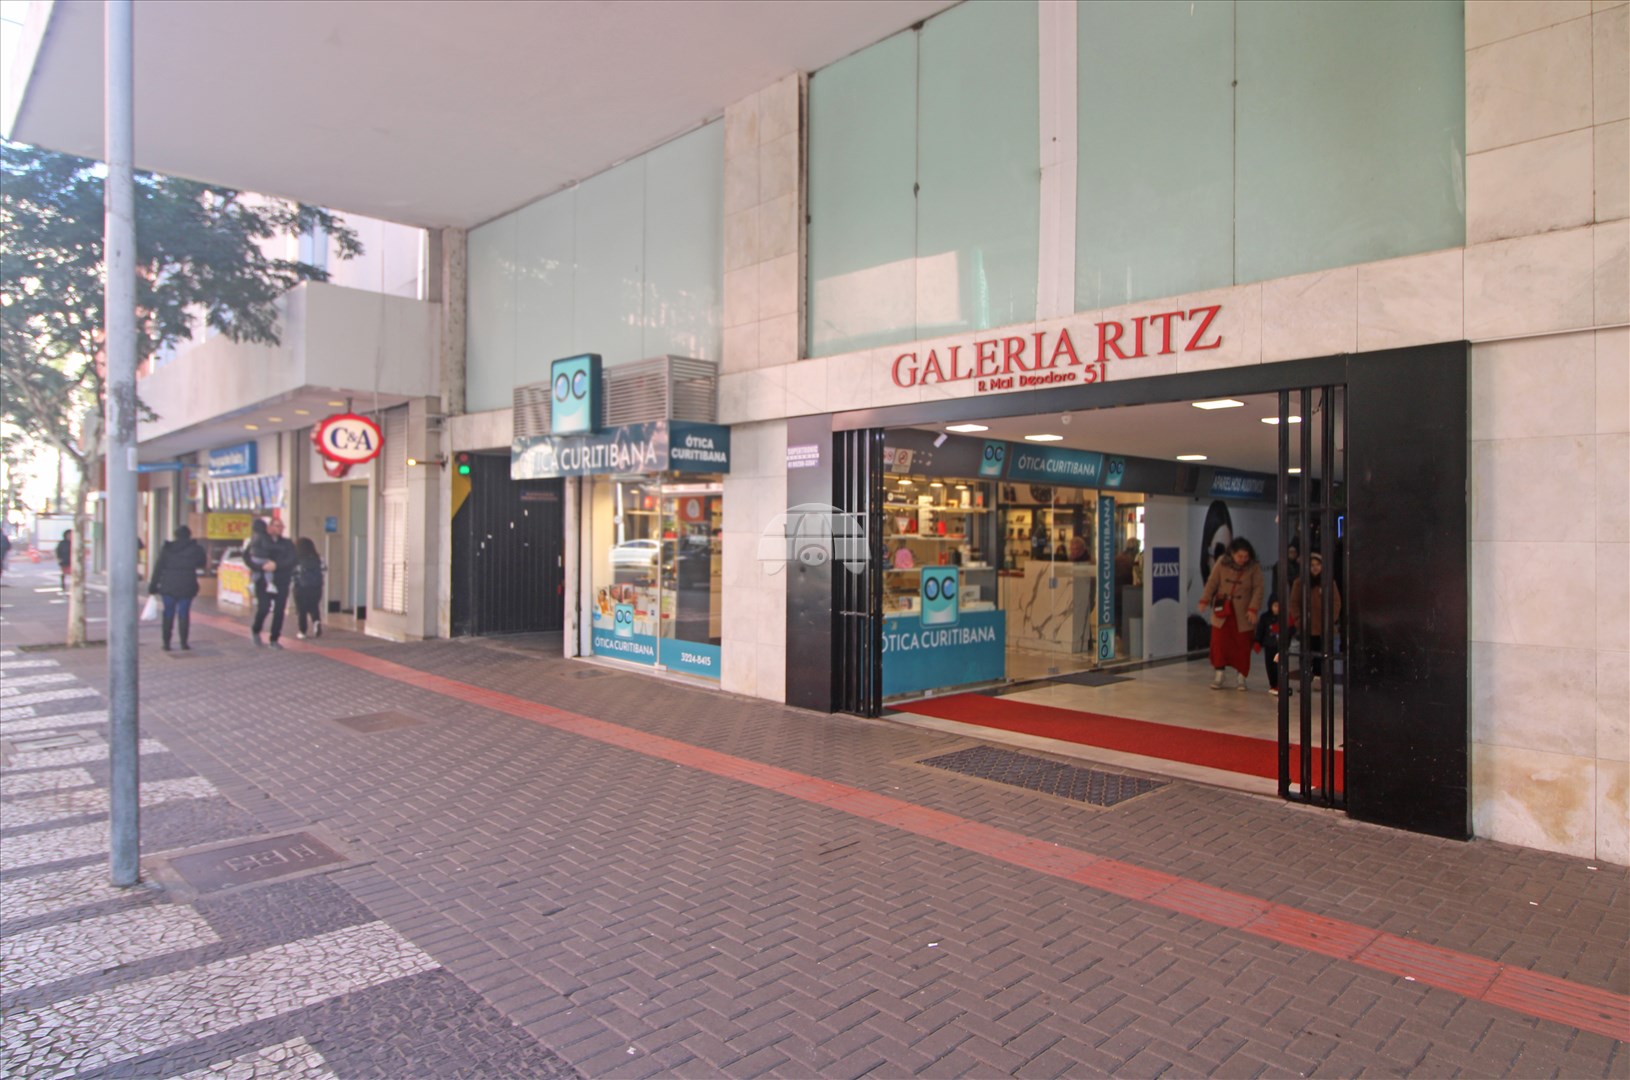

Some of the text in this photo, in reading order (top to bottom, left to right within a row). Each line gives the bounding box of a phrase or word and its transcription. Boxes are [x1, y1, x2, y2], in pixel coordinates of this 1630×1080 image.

[892, 304, 1223, 388] GALERIA RITZ
[555, 369, 587, 402] OC
[990, 376, 1013, 390] Mal
[1019, 370, 1076, 387] Deodoro
[1084, 362, 1106, 384] 51
[330, 427, 374, 451] C&A
[685, 435, 714, 449] ÓTICA
[560, 441, 657, 471] CURITIBANA
[671, 449, 727, 463] CURITIBANA
[984, 445, 1004, 461] OC
[1018, 455, 1095, 476] ÓTICA CURITIBANA
[1109, 461, 1123, 474] OC
[1102, 498, 1111, 624] ÓTICA CURITIBANA
[1153, 562, 1179, 577] ZEISS
[924, 576, 955, 601] OC
[616, 609, 632, 625] OC
[595, 637, 654, 656] ÓTICA CURITIBANA
[920, 626, 996, 649] CURITIBANA
[1101, 630, 1109, 658] OC
